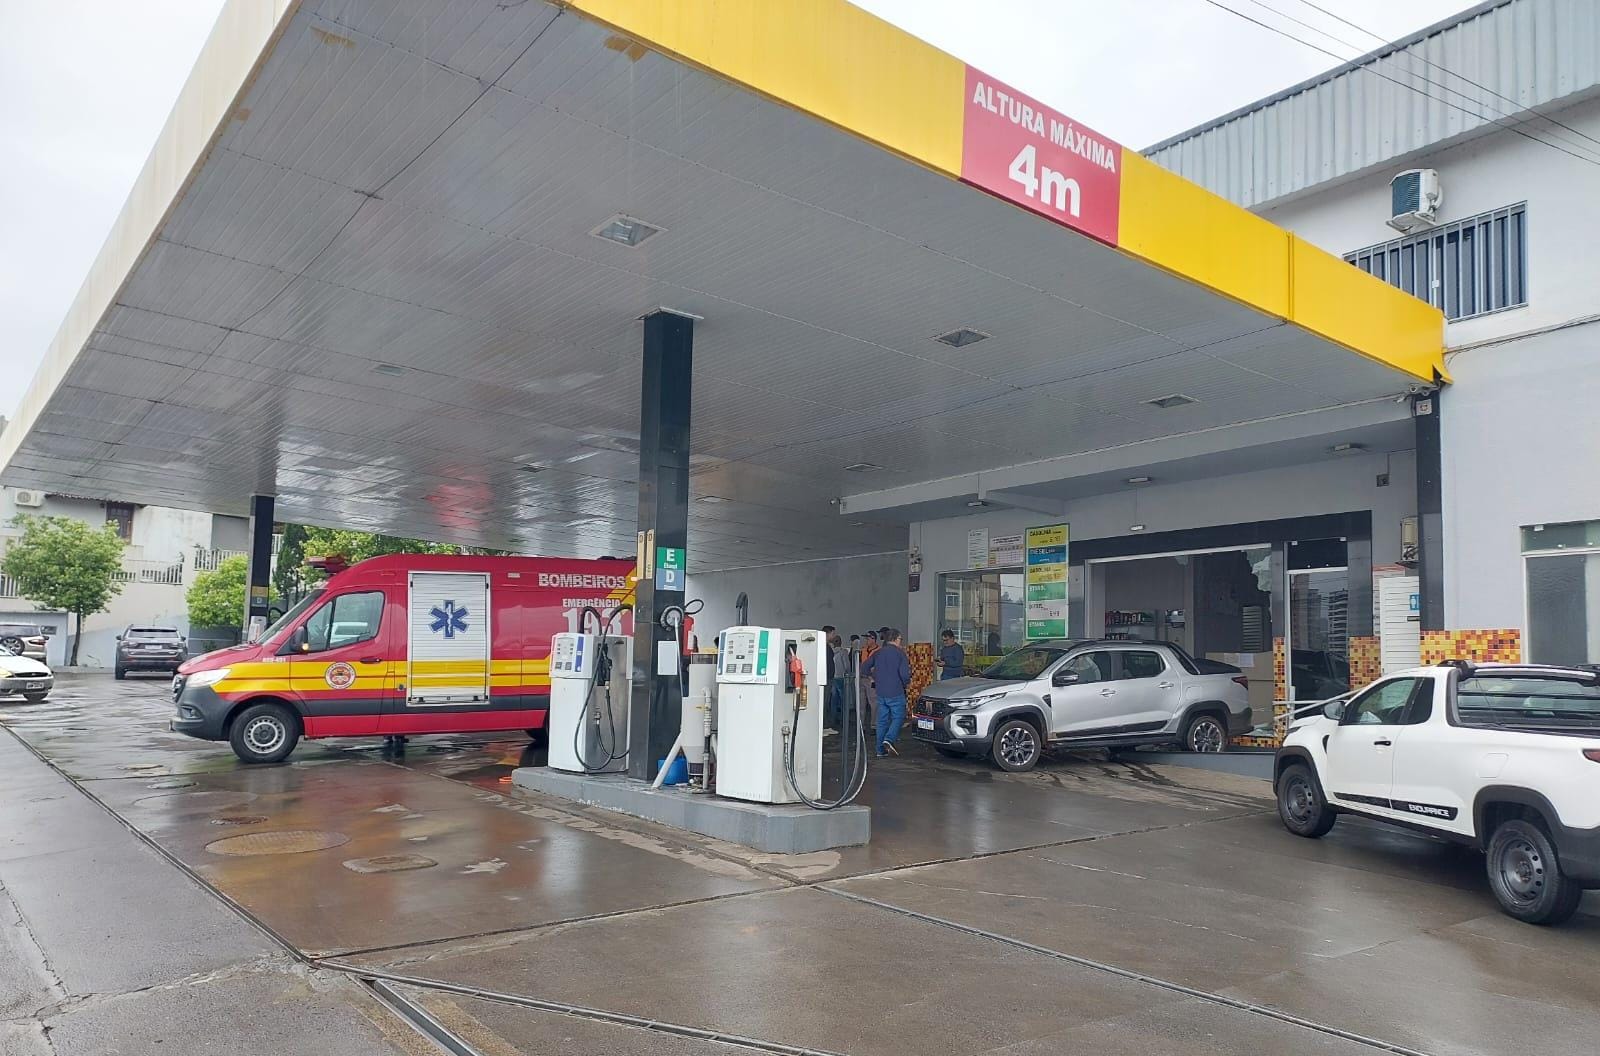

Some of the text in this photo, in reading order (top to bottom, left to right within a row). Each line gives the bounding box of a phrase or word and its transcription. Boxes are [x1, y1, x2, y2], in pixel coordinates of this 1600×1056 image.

[973, 82, 1115, 173] ALTURA MÁXIMA
[1008, 144, 1081, 218] 4m
[666, 548, 676, 562] E
[538, 573, 626, 589] BOMBEIROS
[665, 570, 675, 583] D
[562, 597, 621, 608] EMERGÊNCIA
[562, 607, 622, 635] 193
